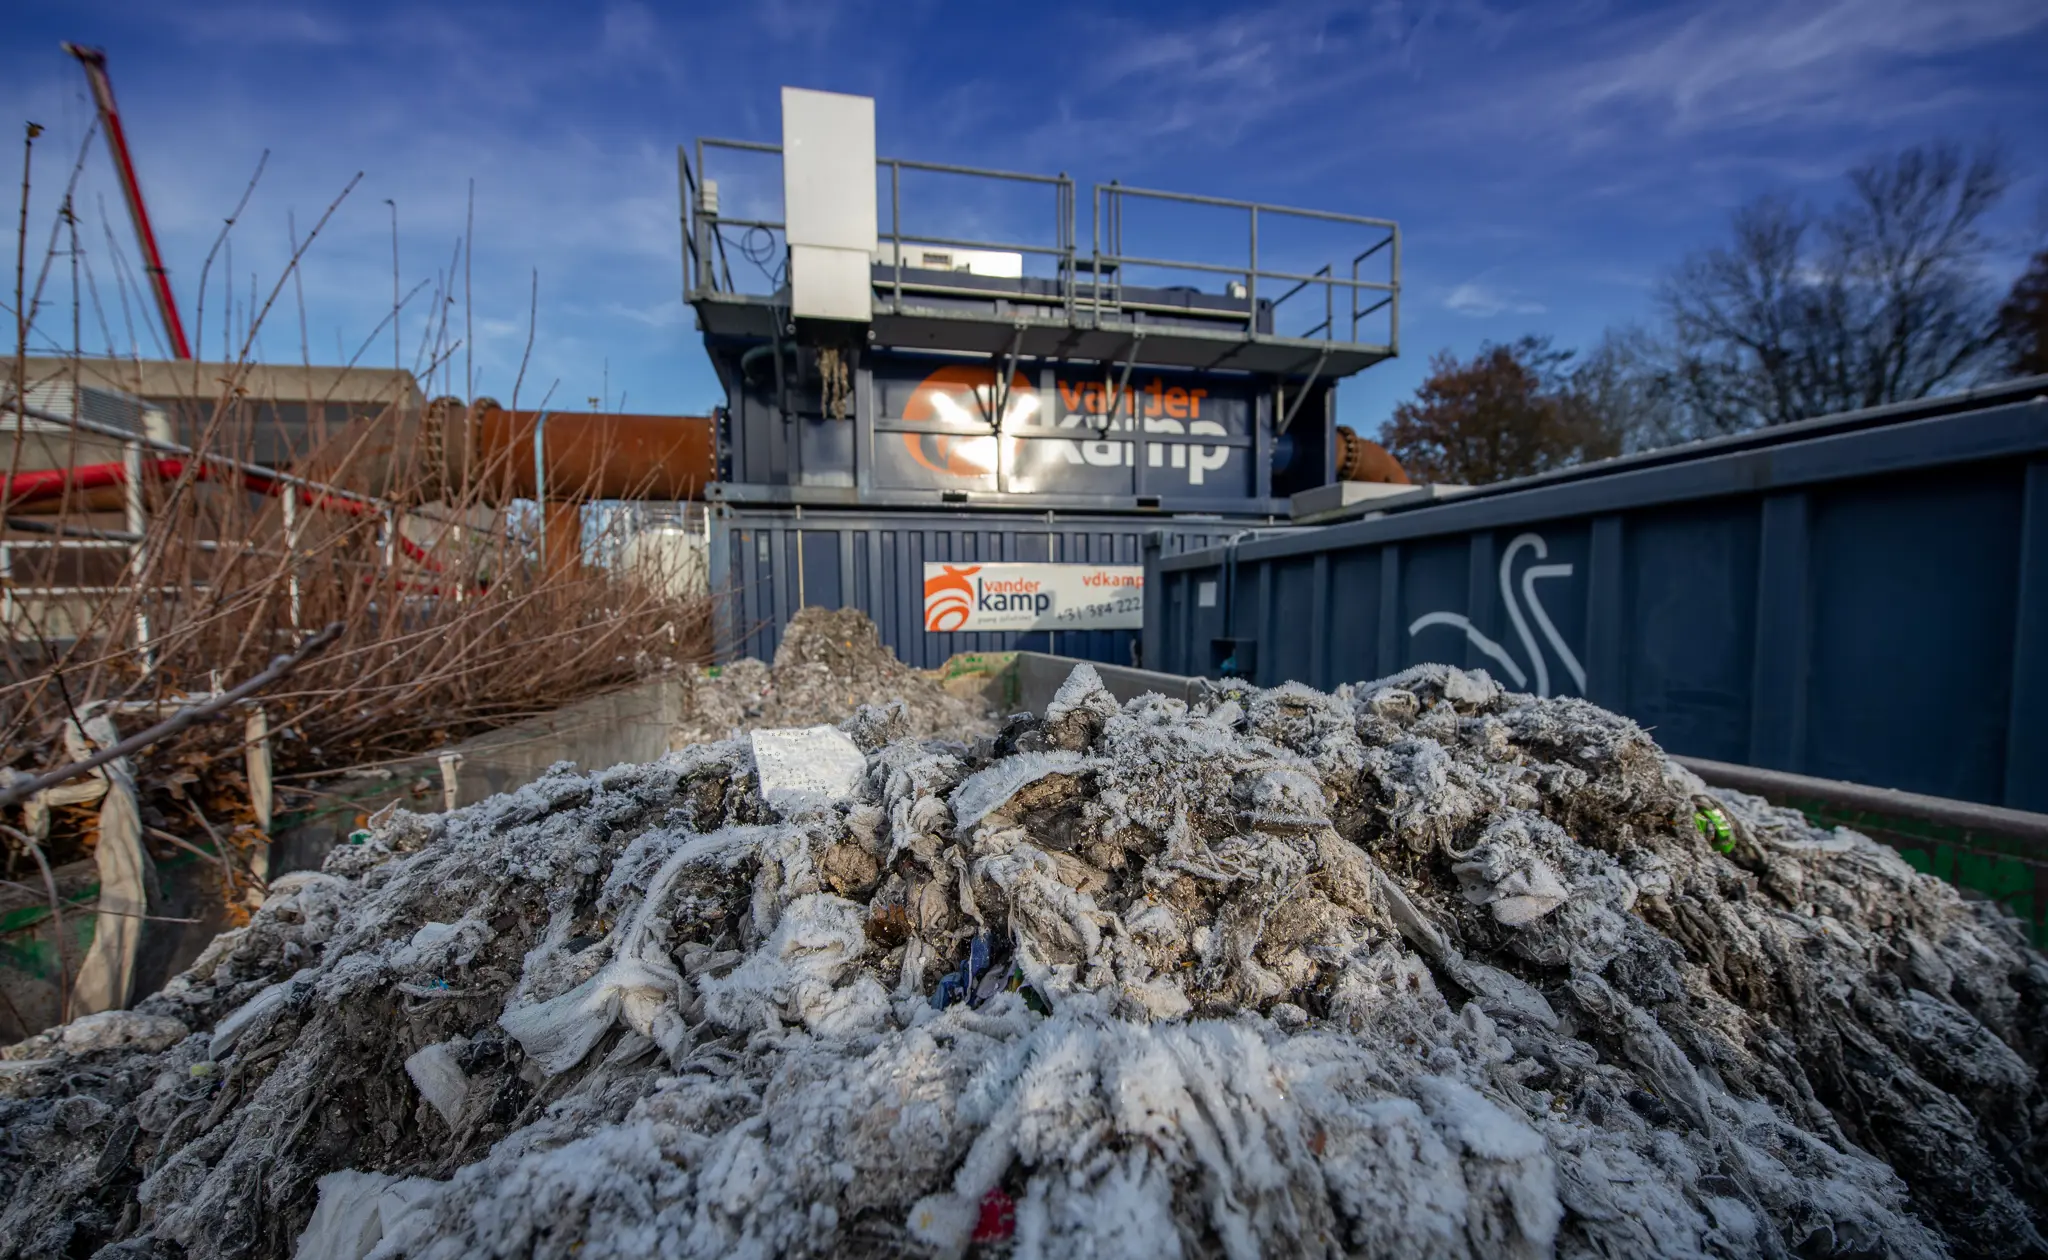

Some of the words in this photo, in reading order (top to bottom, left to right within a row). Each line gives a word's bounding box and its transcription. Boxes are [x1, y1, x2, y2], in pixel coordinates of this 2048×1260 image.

[1040, 369, 1229, 486] kamp
[984, 578, 1041, 593] vander
[1082, 571, 1144, 589] vdkamp
[978, 577, 1050, 616] kamp
